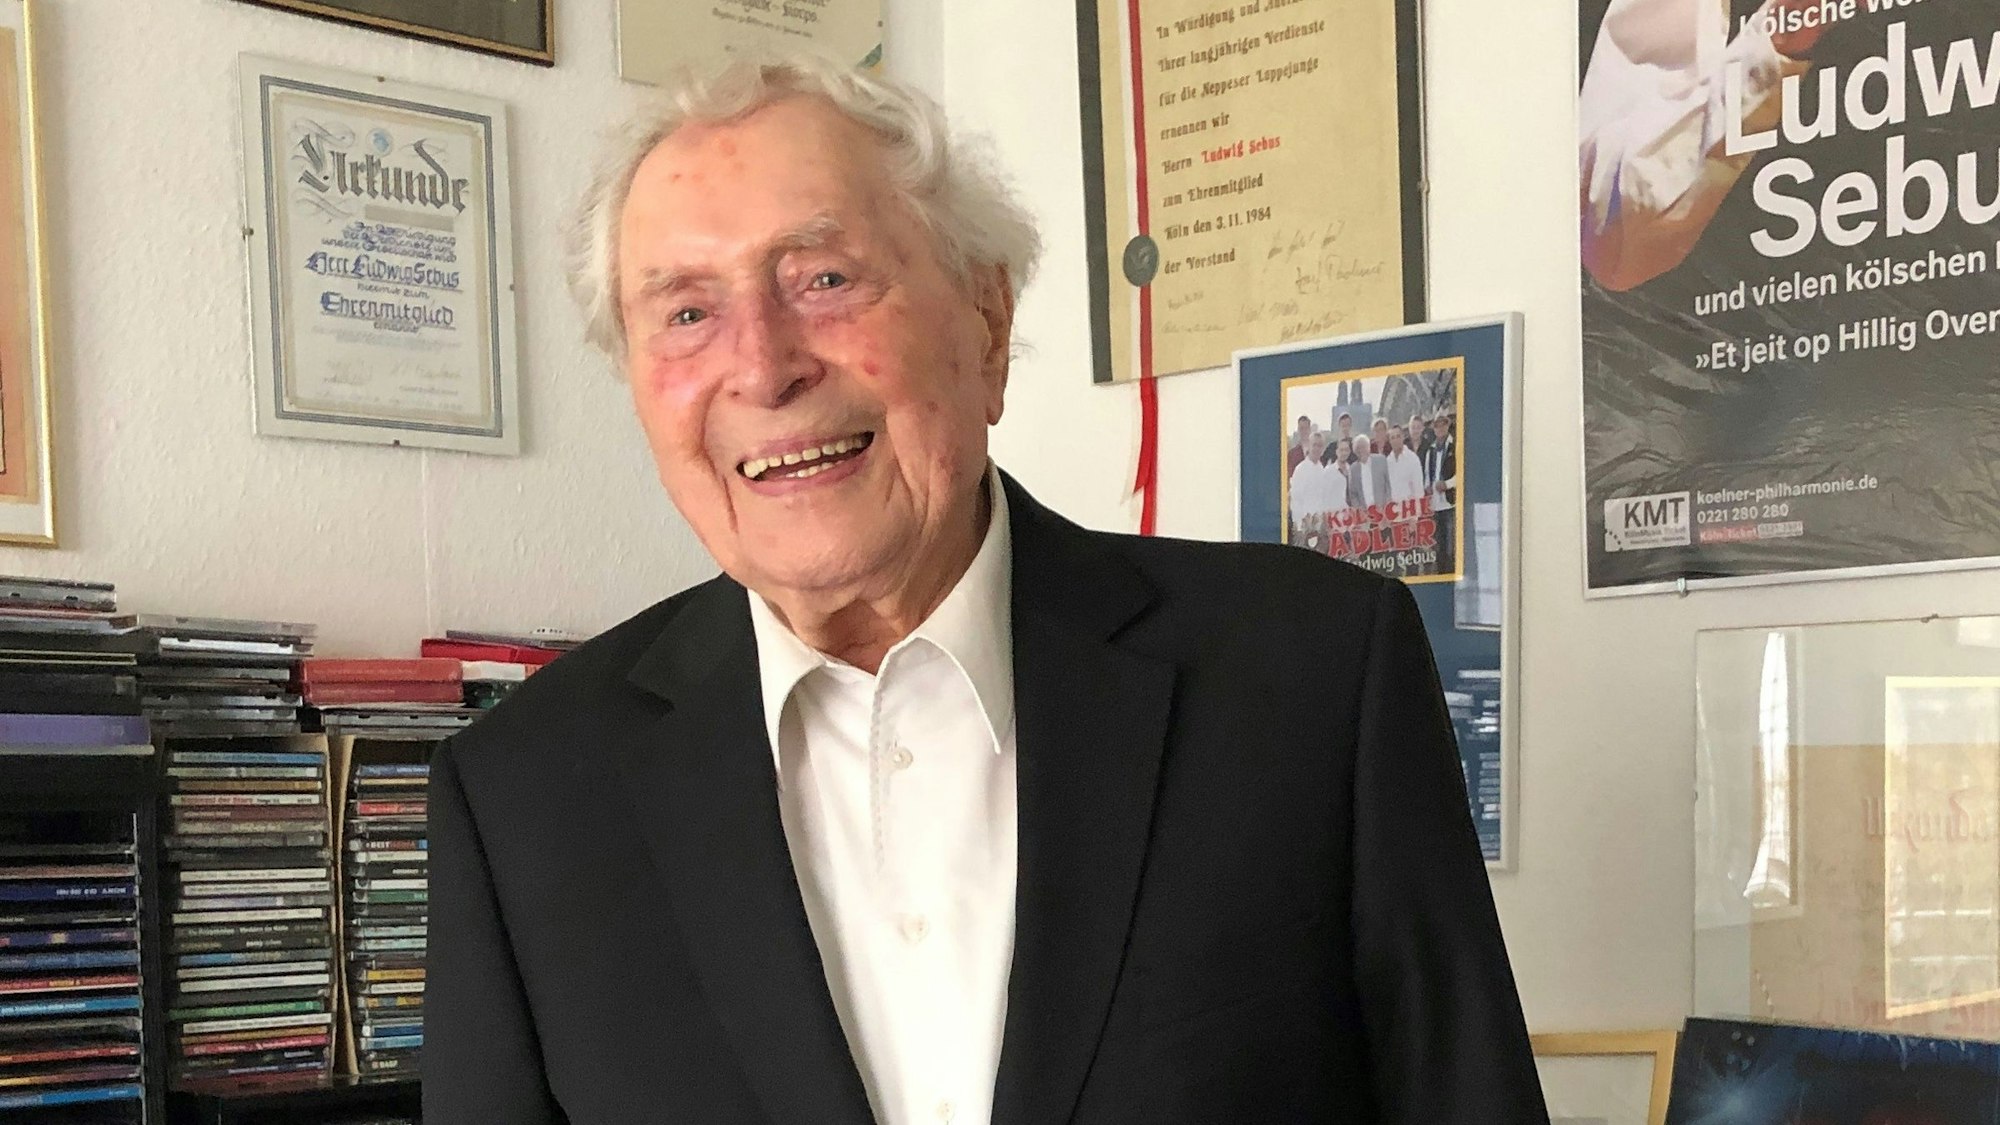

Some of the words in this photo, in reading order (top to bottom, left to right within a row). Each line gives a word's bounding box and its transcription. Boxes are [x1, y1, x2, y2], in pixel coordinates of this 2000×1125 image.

[1156, 25, 1169, 39] In
[1174, 8, 1235, 34] Würdigung
[1240, 2, 1260, 17] und
[1158, 54, 1186, 72] Ihrer
[1191, 37, 1260, 64] langjährigen
[1264, 20, 1325, 45] Verdienste
[1160, 92, 1176, 107] für
[1181, 86, 1197, 100] die
[1201, 74, 1250, 98] Neppeser
[1161, 119, 1207, 140] ernennen
[1212, 112, 1230, 128] wir
[297, 132, 470, 213] Urkunde
[1161, 157, 1192, 174] Herrn
[1201, 140, 1243, 164] Ludwig
[1249, 136, 1280, 154] Sebus
[1163, 194, 1182, 208] zum
[1187, 173, 1263, 202] Ehrenmitglied
[1750, 135, 2000, 258] Sebu
[1164, 222, 1189, 240] Köln
[1193, 218, 1212, 234] den
[414, 262, 459, 289] Sebus
[1164, 258, 1181, 274] der
[1186, 248, 1235, 270] Vorstand
[1695, 281, 1745, 316] und
[1752, 271, 1837, 307] vielen
[1846, 250, 1986, 292] kölschen
[320, 291, 454, 326] Ehrenmitglied
[1741, 334, 1787, 373] jeit
[1793, 332, 1830, 363] op
[1839, 316, 1917, 352] Hillig
[1697, 474, 1878, 505] koelner-philharmonie.de
[1624, 497, 1686, 529] KMT
[1697, 508, 1728, 525] 0221
[1732, 505, 1758, 521] 280
[1762, 502, 1789, 518] 280
[1328, 518, 1437, 559] ADLER
[1347, 552, 1395, 572] dwig
[1397, 549, 1437, 567] Sebus
